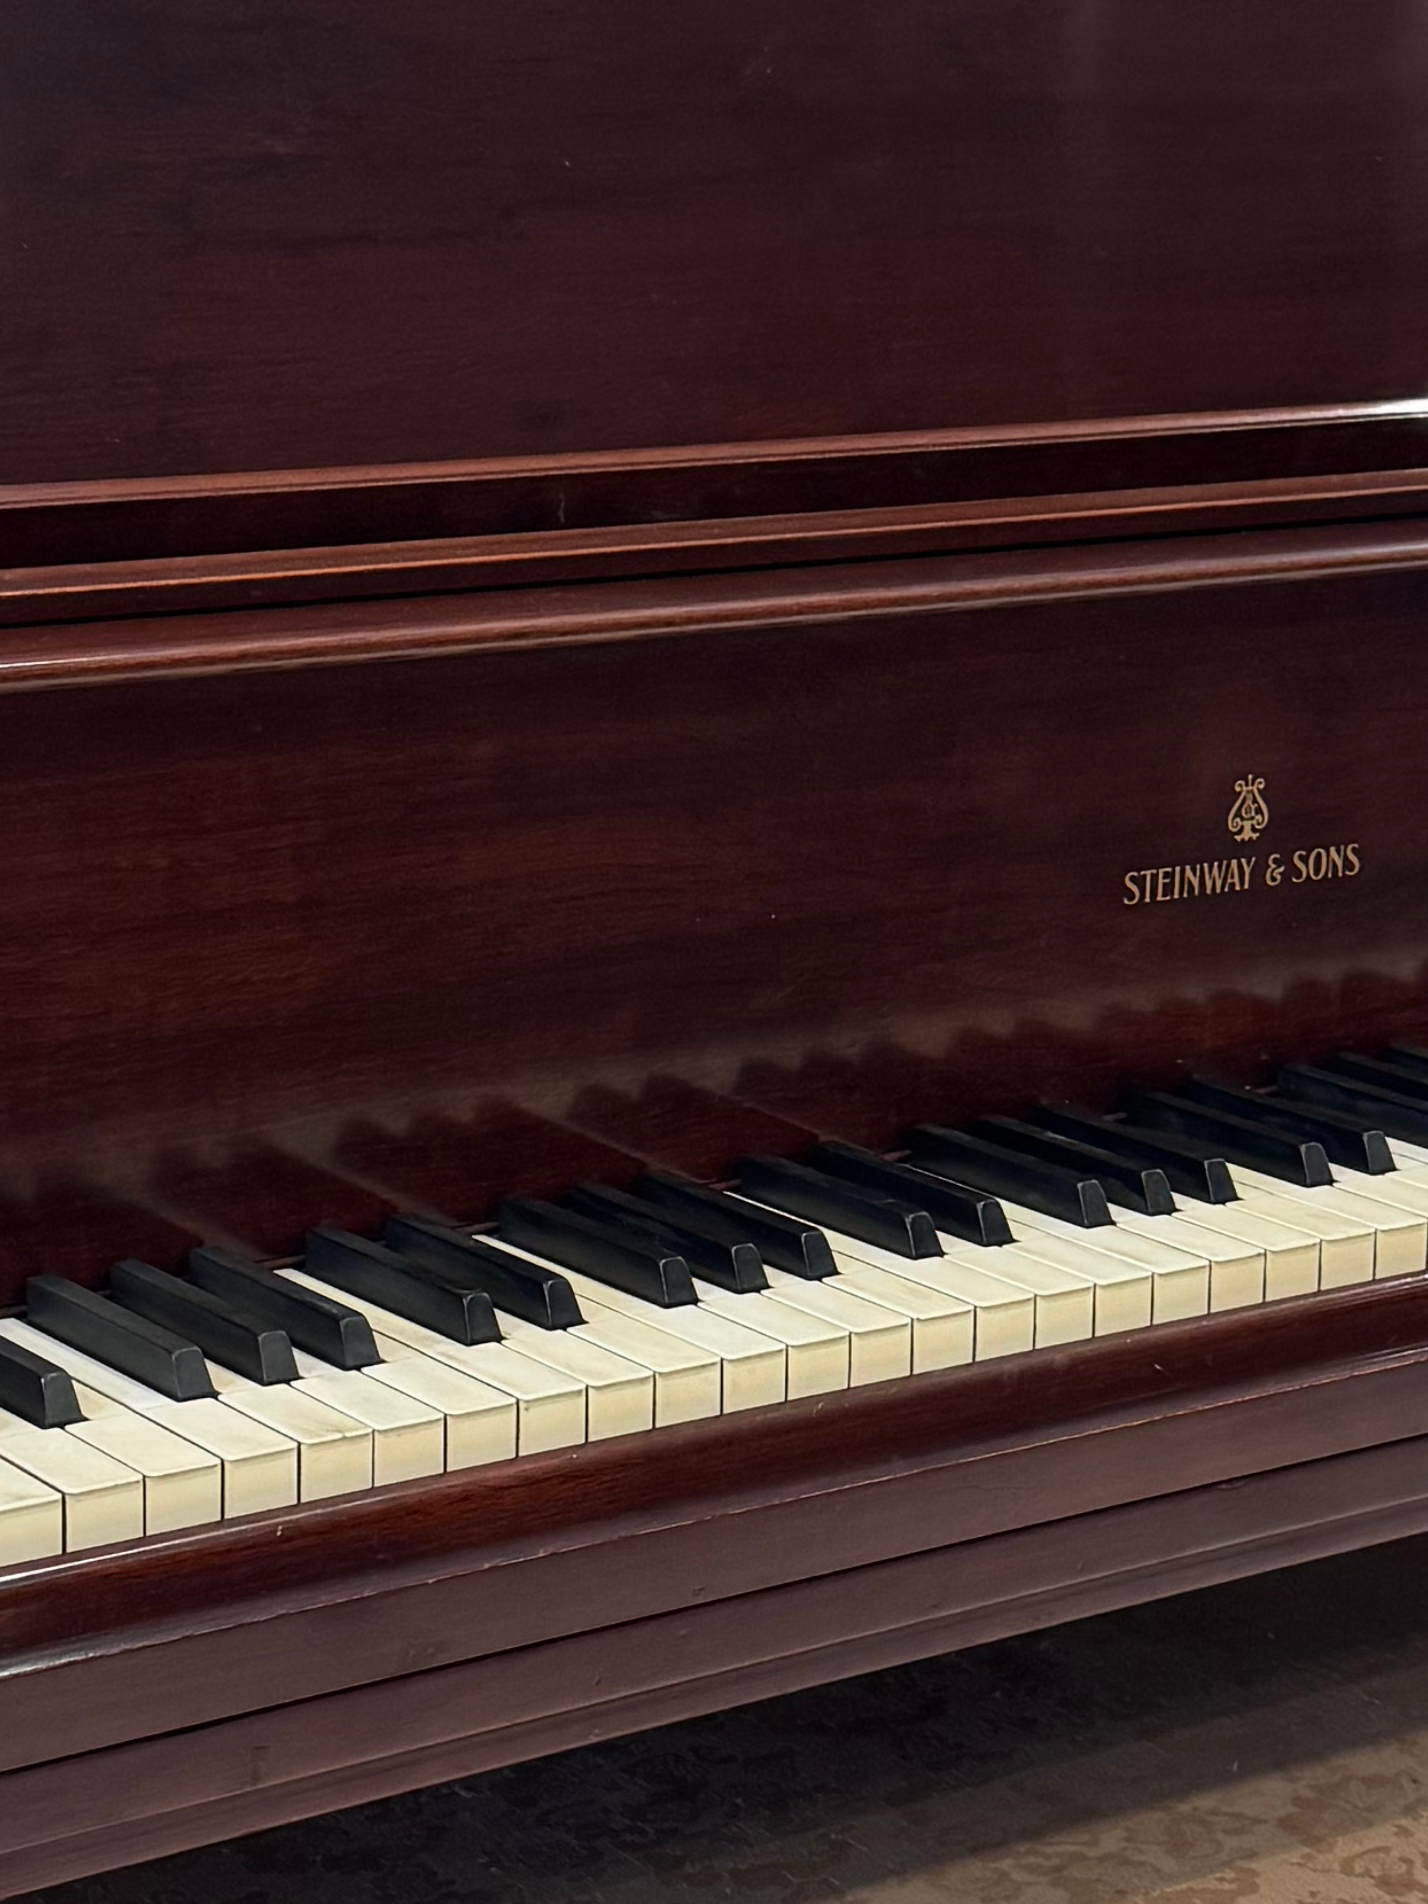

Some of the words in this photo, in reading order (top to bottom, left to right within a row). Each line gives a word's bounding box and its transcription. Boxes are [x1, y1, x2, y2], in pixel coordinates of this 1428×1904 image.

[1123, 856, 1256, 905] STEINWAY
[1265, 853, 1285, 886] &
[1291, 843, 1360, 883] SONS
